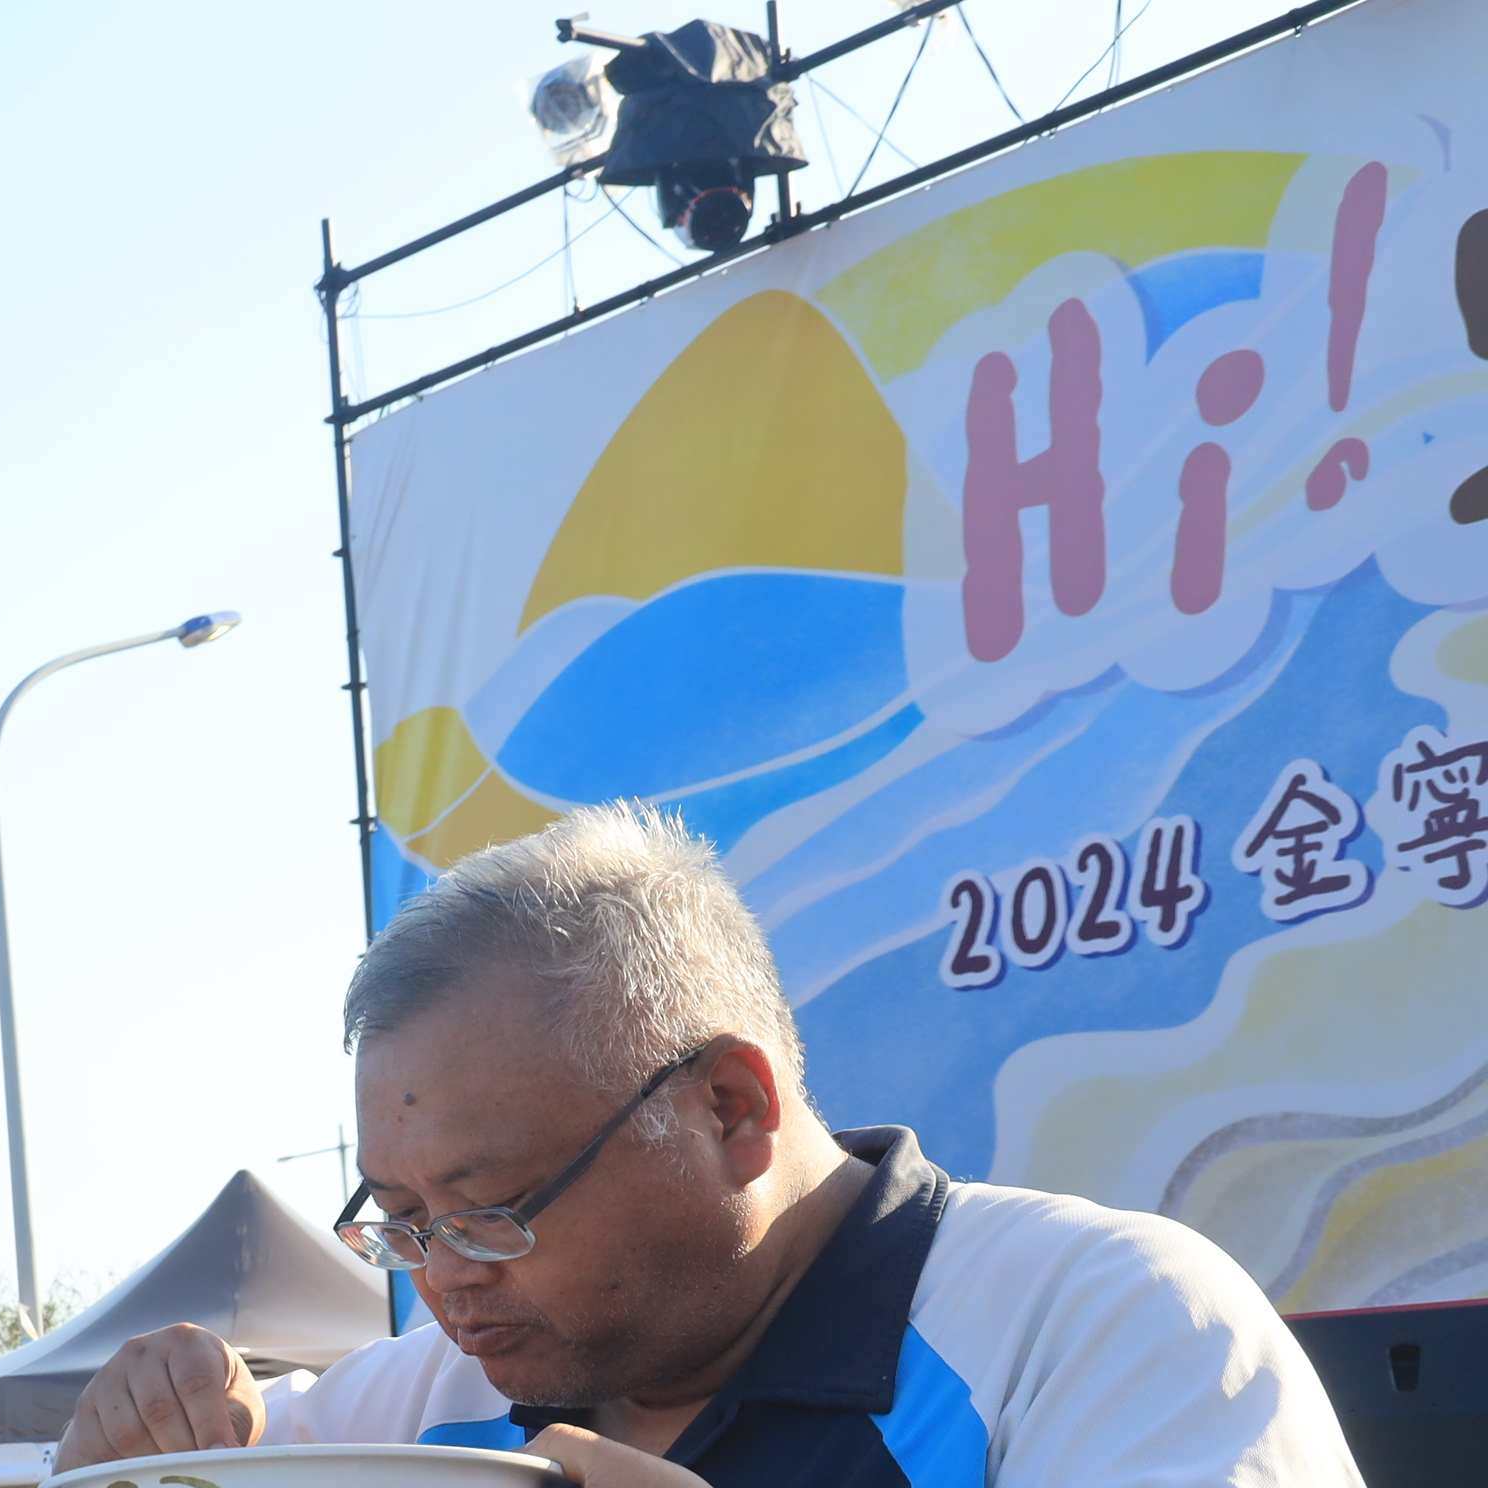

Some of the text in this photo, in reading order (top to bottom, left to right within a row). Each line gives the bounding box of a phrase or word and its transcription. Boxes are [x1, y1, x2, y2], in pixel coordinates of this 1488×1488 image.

[962, 161, 1387, 663] Hi!
[950, 740, 1488, 976] 2024 金寧
